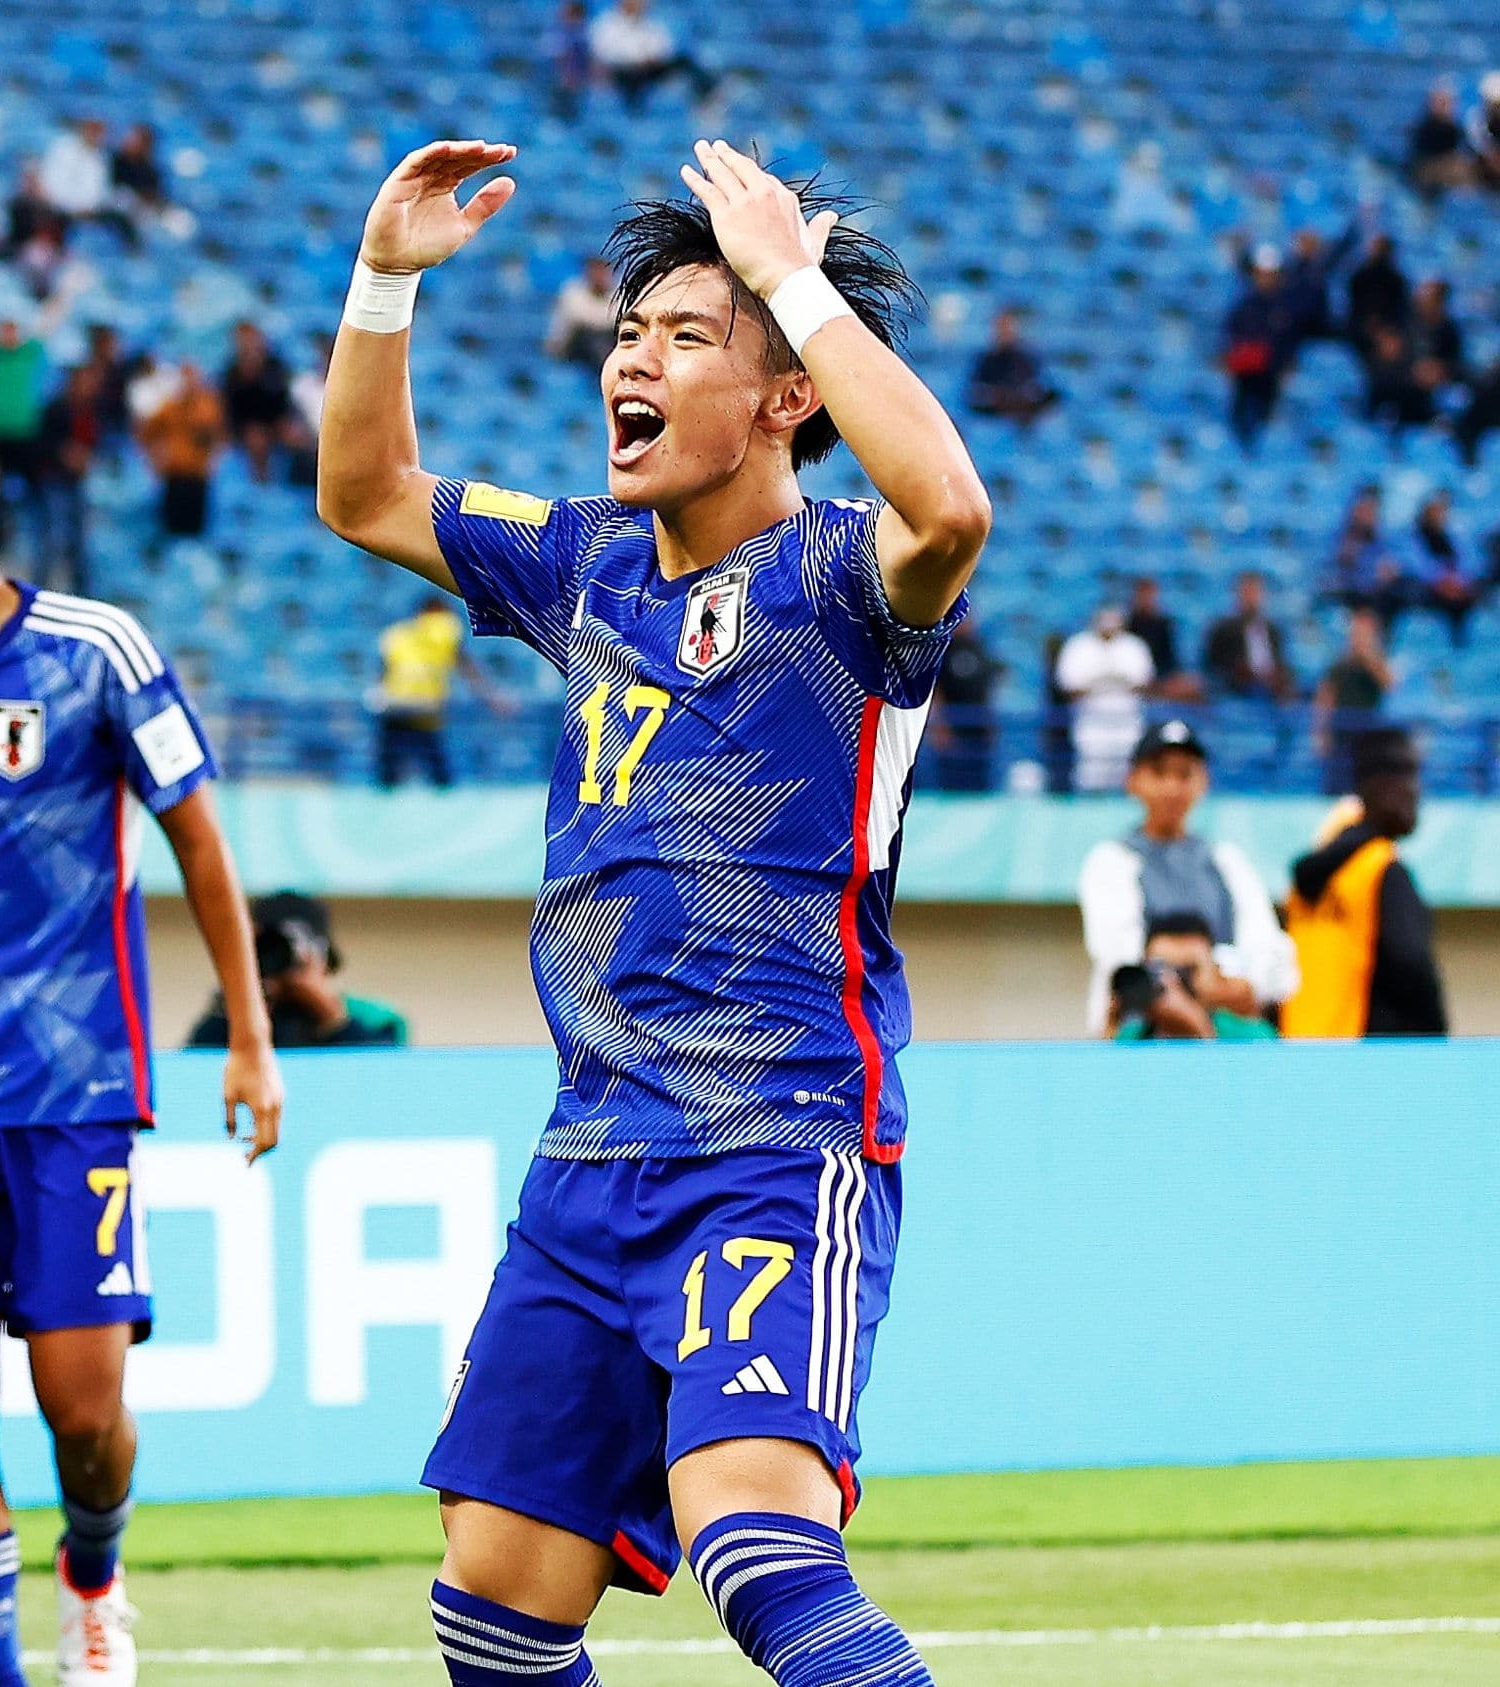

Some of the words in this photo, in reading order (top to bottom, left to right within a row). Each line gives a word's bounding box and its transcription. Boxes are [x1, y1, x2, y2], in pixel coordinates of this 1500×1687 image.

[700, 575, 731, 593] JAPAN
[579, 681, 671, 807] 17
[87, 1166, 130, 1256] 7
[677, 1237, 795, 1363] 17
